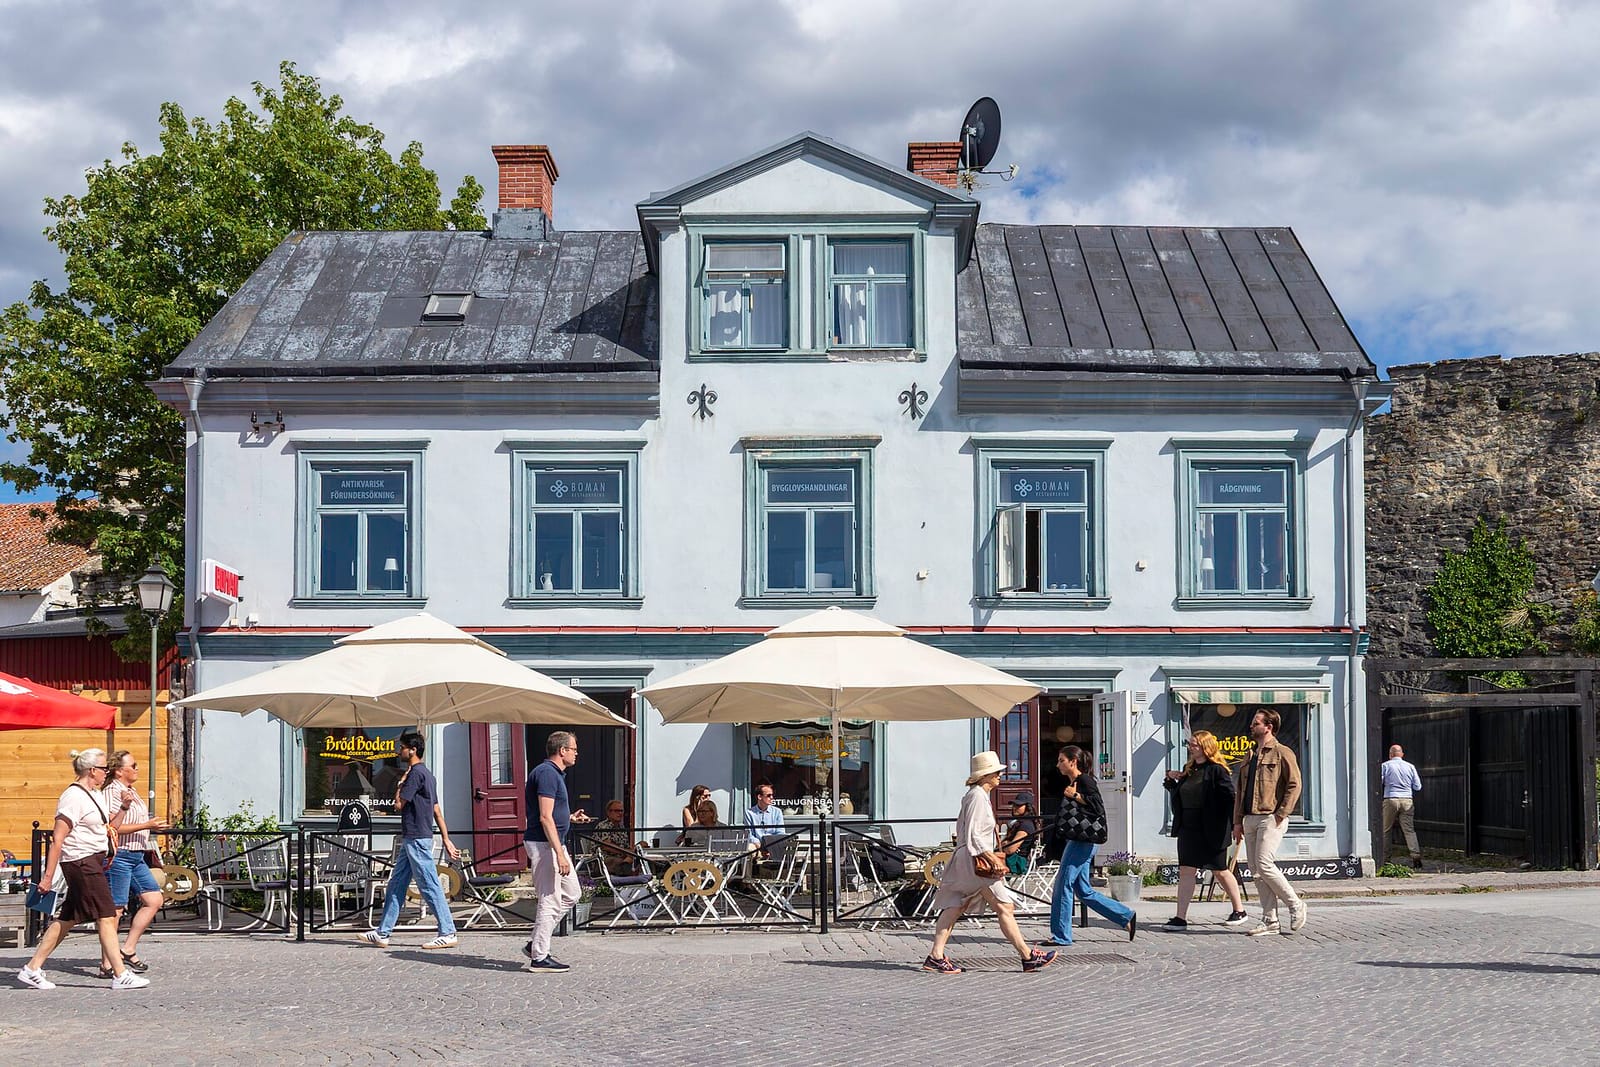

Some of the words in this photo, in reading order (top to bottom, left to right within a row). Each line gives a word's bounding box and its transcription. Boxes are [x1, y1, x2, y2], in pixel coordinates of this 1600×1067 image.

[341, 480, 385, 488] ANTIKVARISK
[571, 482, 606, 492] BOMAN
[771, 483, 848, 492] BYGGLOVSHANDLINGAR
[1035, 481, 1070, 491] BOMAN
[1220, 483, 1261, 493] RÅDGIVNING
[330, 490, 395, 499] FÖRUNDERSÖKNING
[770, 798, 849, 806] STENUGNSBAAT
